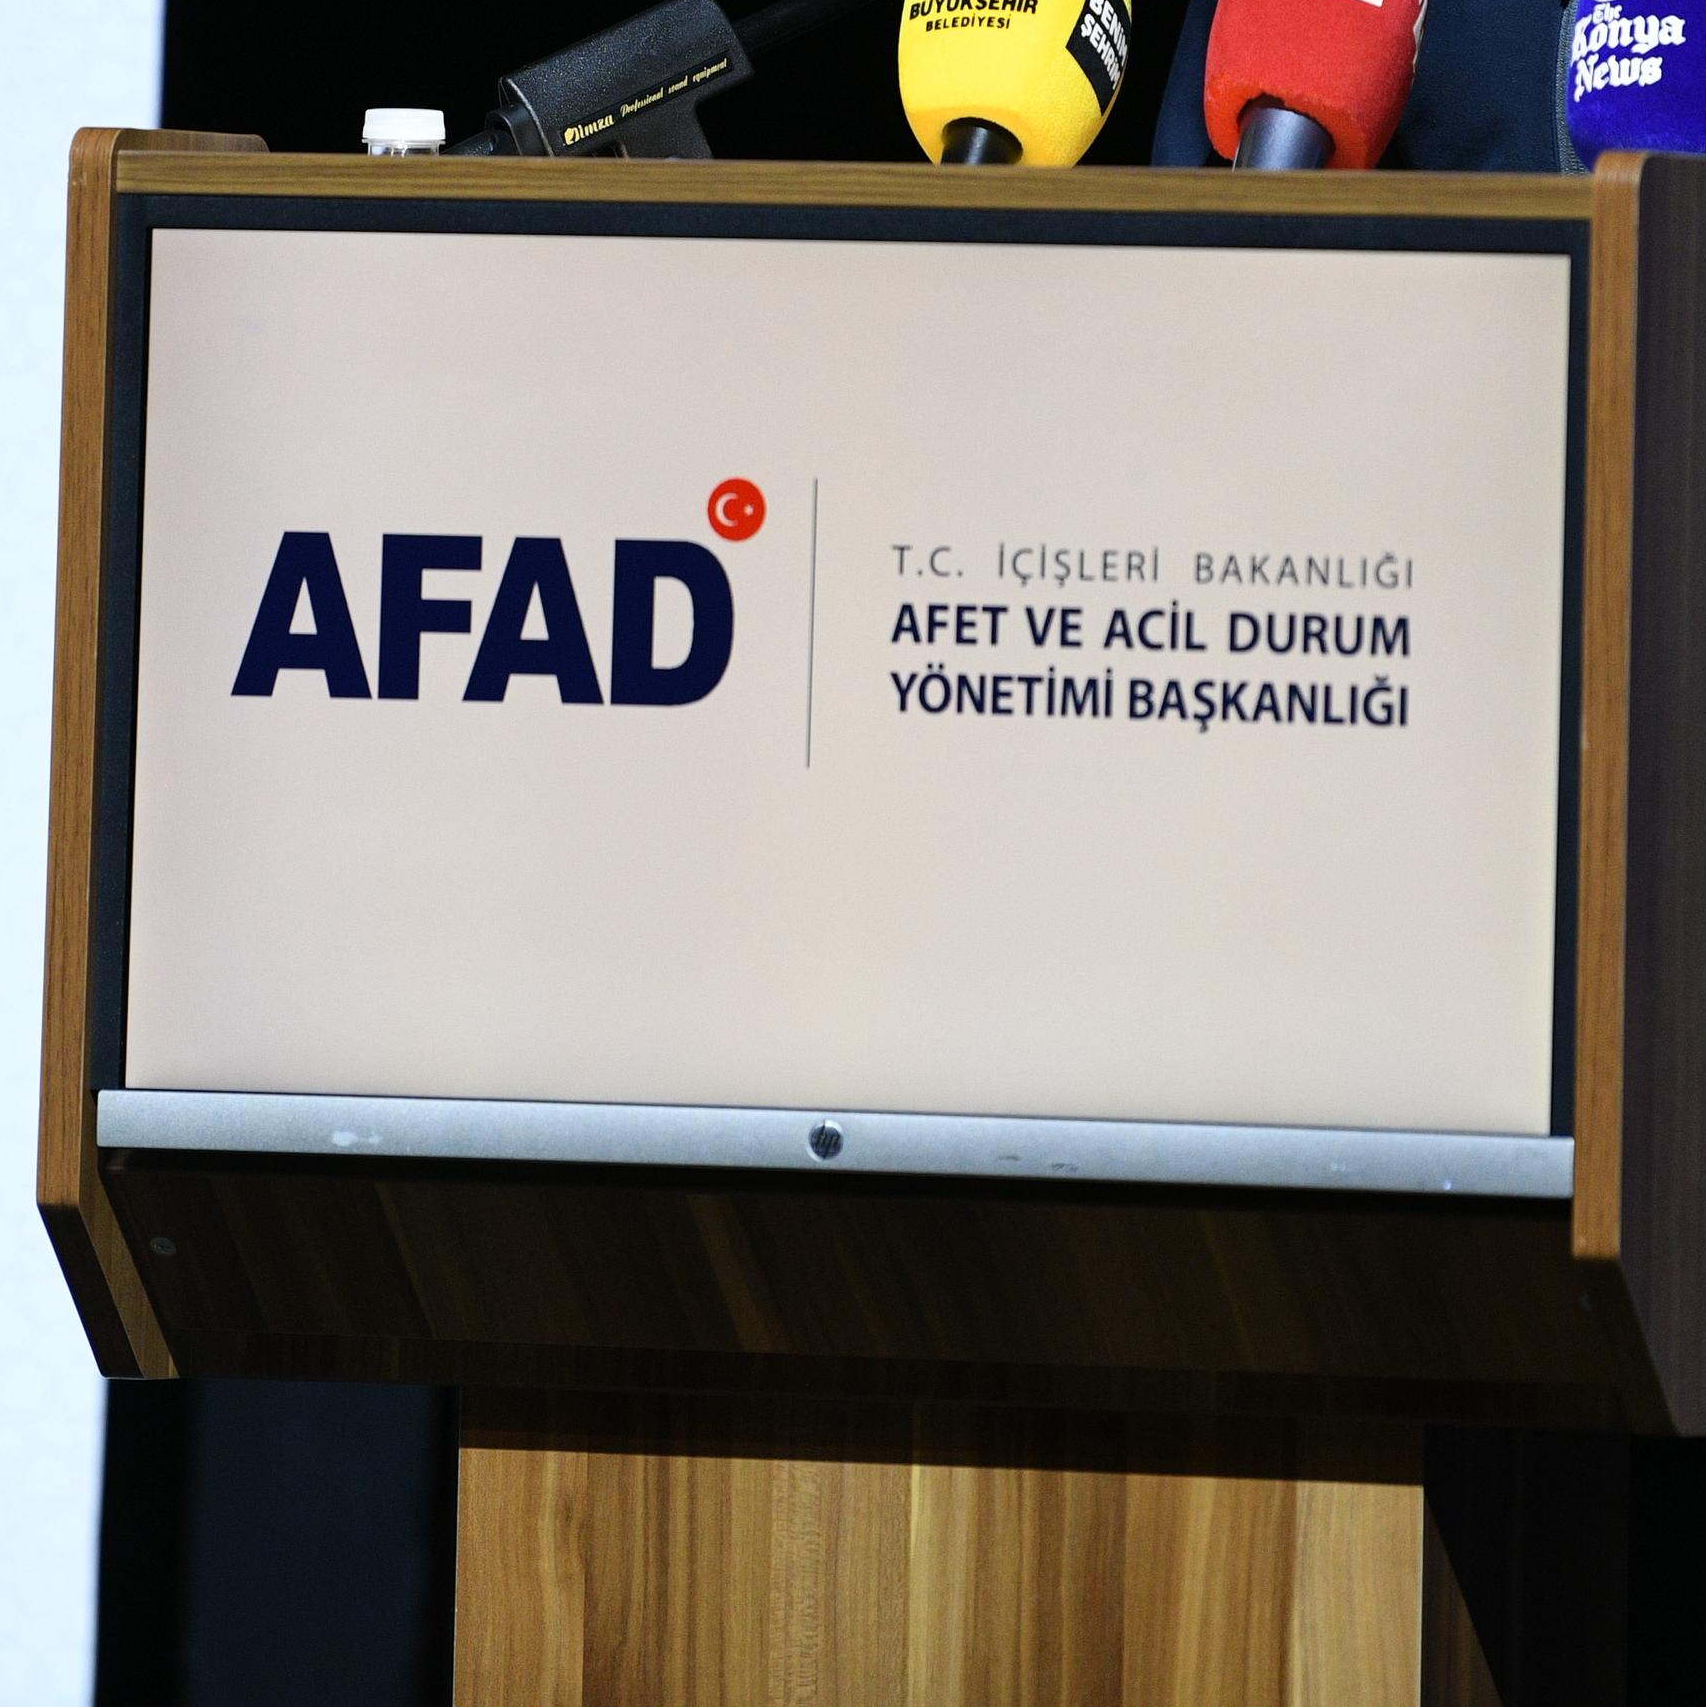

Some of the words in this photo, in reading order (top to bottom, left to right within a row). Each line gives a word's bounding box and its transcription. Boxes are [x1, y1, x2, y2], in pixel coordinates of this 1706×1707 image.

[925, 13, 1011, 32] BELEDİYESİ
[1570, 14, 1687, 68] Konya
[620, 86, 664, 118] Professional
[1573, 54, 1663, 103] News
[890, 543, 965, 579] T.C.
[997, 541, 1161, 588] İÇİŞLERİ
[1194, 551, 1414, 590] BAKANLIĞI
[231, 530, 736, 707] AFAD
[891, 603, 1009, 647] AFET
[1024, 605, 1084, 649] VE
[1103, 600, 1208, 652] ACİL
[1228, 611, 1411, 657] DURUM
[890, 662, 1114, 719] YÖNETİMİ
[1127, 674, 1409, 733] BAŞKANLIĞI
